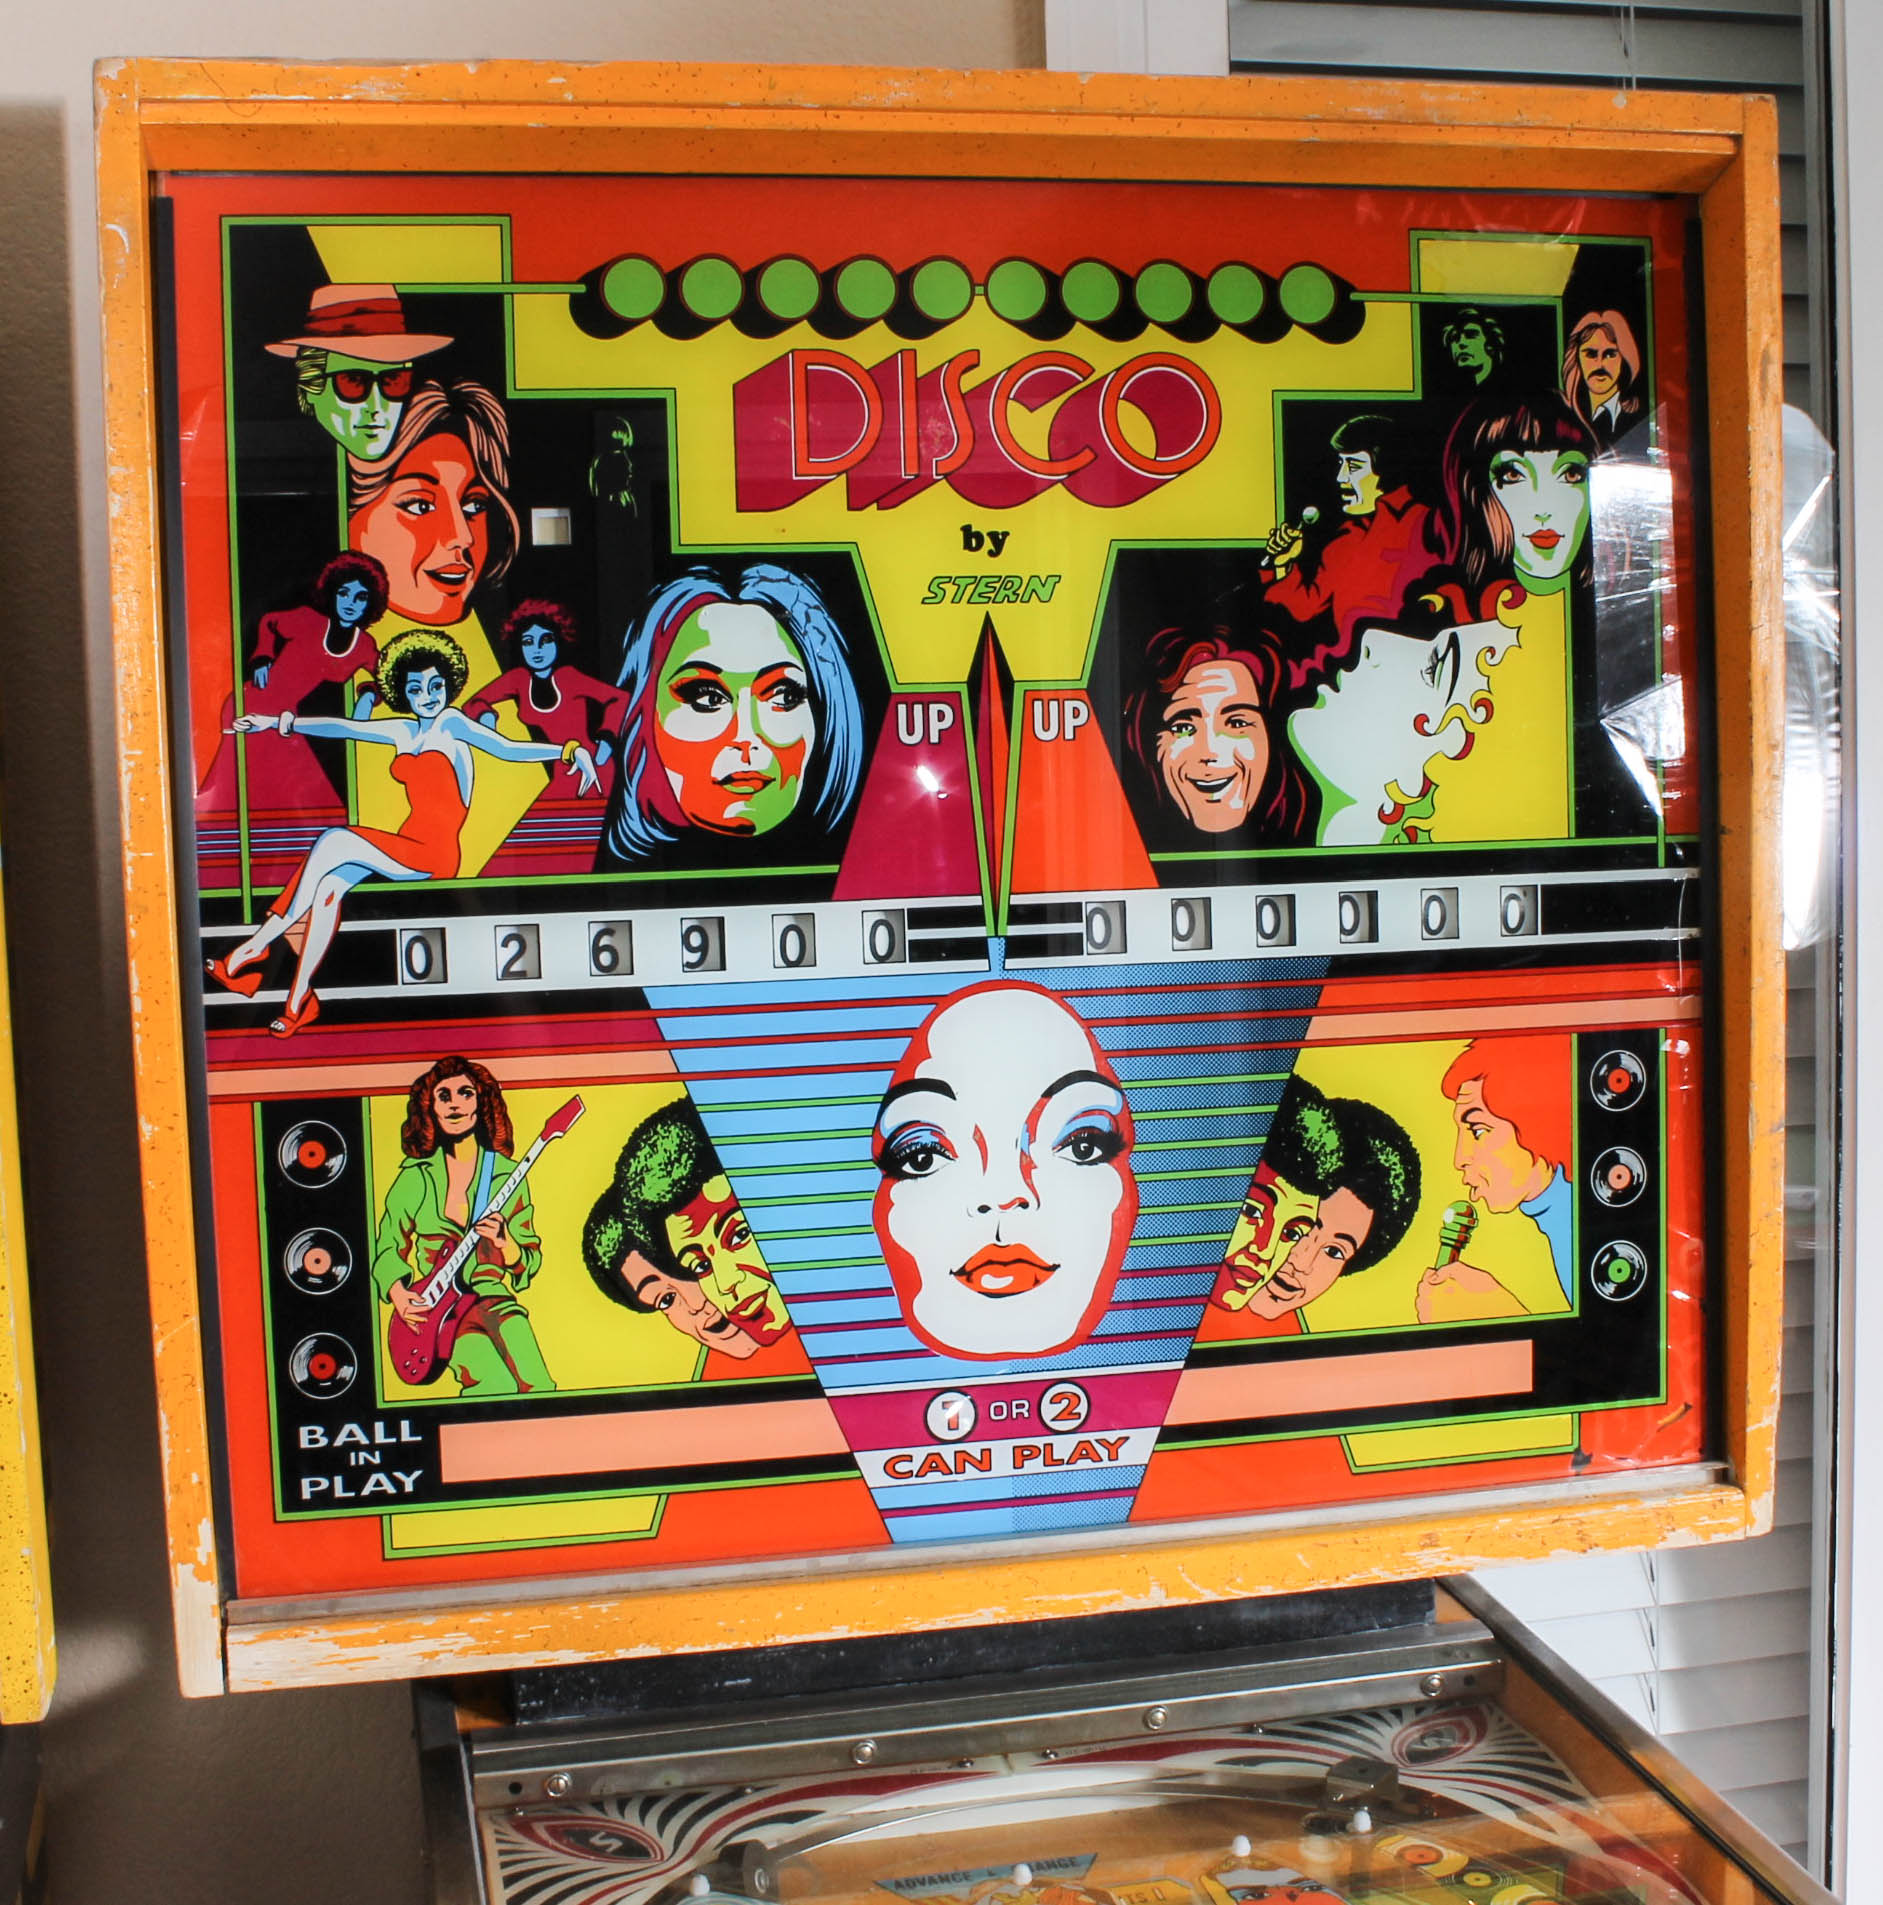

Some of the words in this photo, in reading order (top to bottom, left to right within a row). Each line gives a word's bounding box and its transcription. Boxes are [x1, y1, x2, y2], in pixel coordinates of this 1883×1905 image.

[788, 349, 1222, 480] DISCO
[960, 524, 1010, 557] by
[921, 575, 1061, 605] STERN
[897, 702, 955, 746] UP
[1032, 699, 1090, 741] UP
[1086, 906, 1112, 949] 0
[1173, 899, 1196, 942] 0
[1258, 897, 1281, 940] 0
[1339, 894, 1361, 936] 0
[1424, 893, 1447, 936] 0
[1502, 892, 1525, 934] 0
[405, 935, 434, 980] 0
[500, 932, 527, 978] 2
[591, 927, 619, 973] 6
[682, 923, 710, 969] 9
[779, 923, 807, 968] 0
[869, 918, 896, 963] 0
[942, 1400, 960, 1431] 1
[989, 1400, 1030, 1421] OR
[1050, 1391, 1082, 1422] 2
[299, 1420, 422, 1448] BALL
[350, 1451, 381, 1466] IN
[883, 1448, 993, 1480] CAN
[1012, 1436, 1130, 1470] PLAY
[301, 1470, 423, 1500] PLAY
[894, 1871, 973, 1891] ADVANCE
